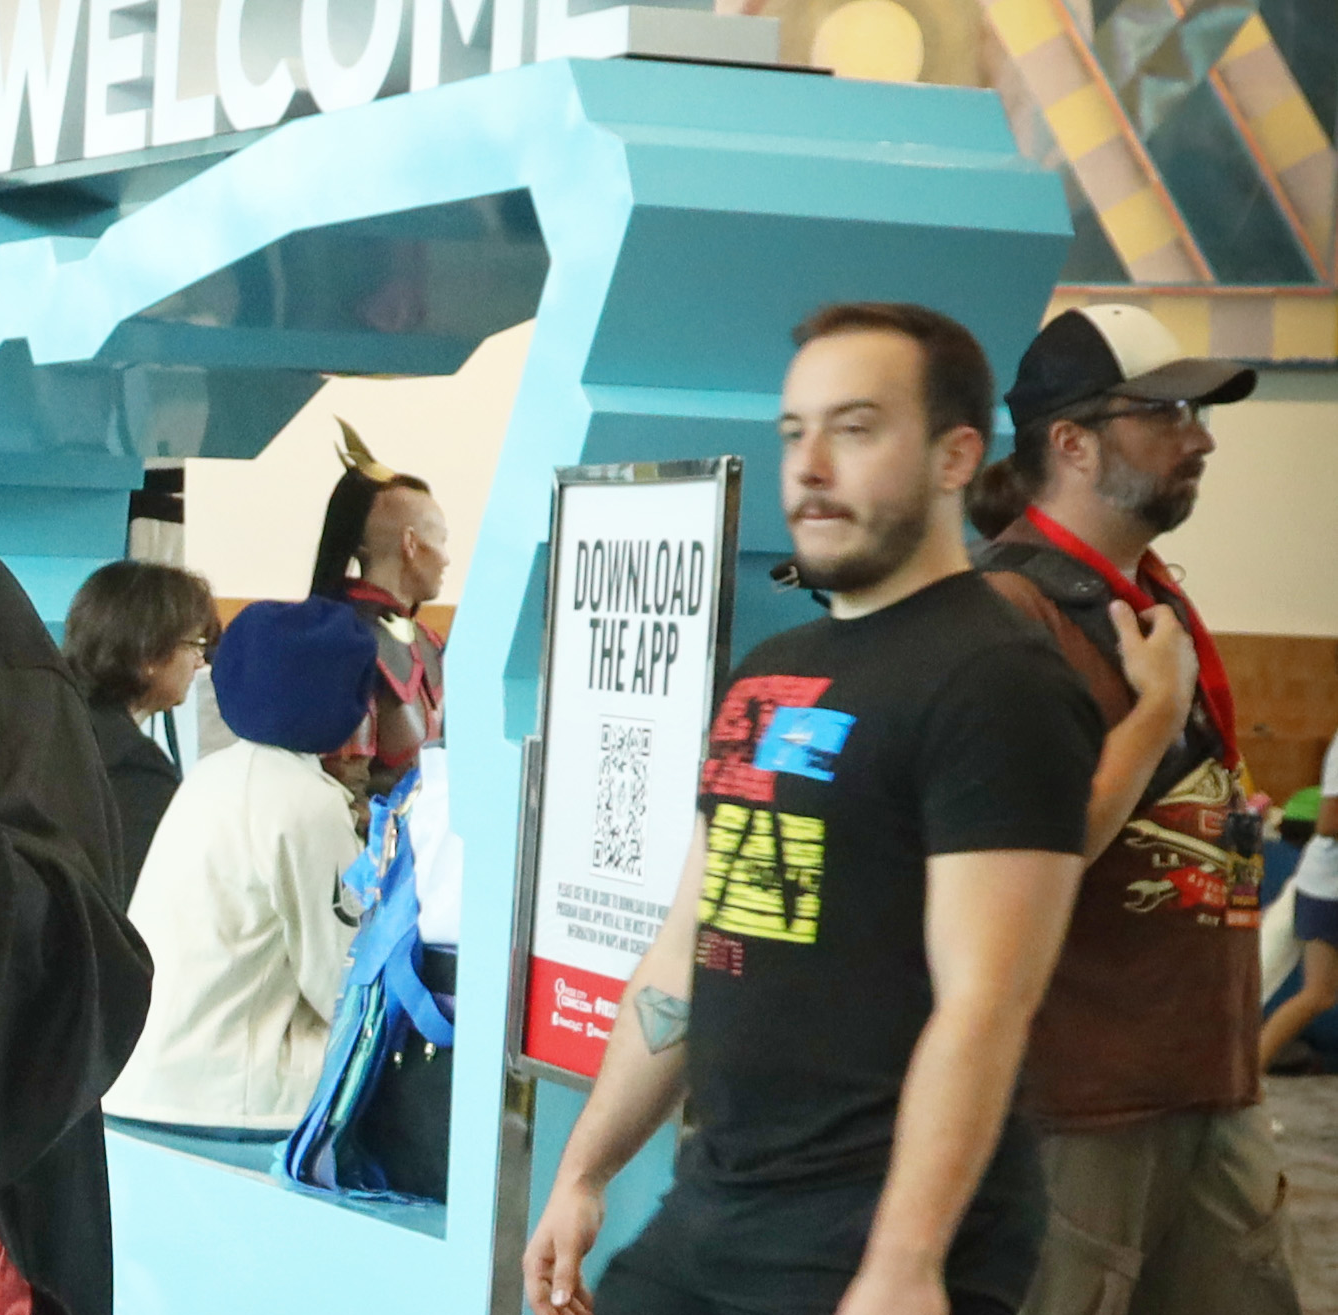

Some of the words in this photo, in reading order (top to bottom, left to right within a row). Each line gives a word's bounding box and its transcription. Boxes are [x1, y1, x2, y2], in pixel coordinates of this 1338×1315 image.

[574, 539, 705, 616] DOWNLOAD
[588, 618, 629, 692] THE
[631, 620, 679, 696] APP
